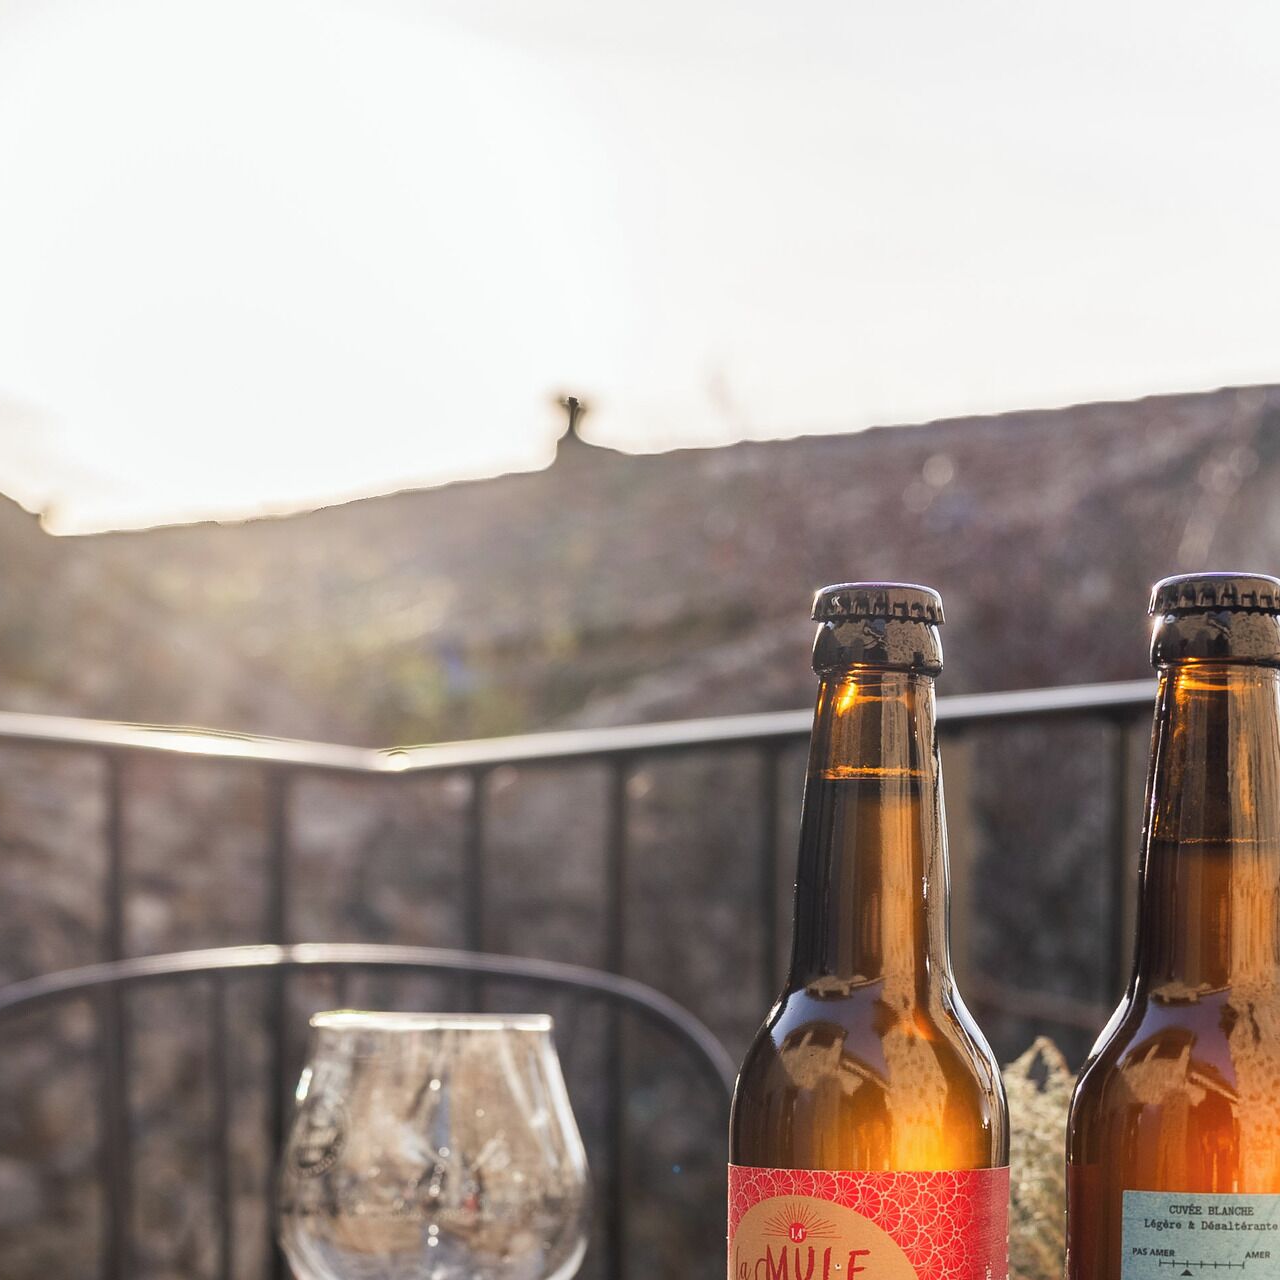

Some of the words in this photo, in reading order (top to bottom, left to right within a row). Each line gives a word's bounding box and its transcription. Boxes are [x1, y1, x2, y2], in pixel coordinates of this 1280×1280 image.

[1169, 1204, 1202, 1216] CUVÉE
[1208, 1206, 1254, 1216] BLANCHE
[1144, 1218, 1182, 1232] Légère
[1188, 1220, 1195, 1230] &
[1201, 1220, 1278, 1231] Désaltérante
[1132, 1247, 1148, 1256] PAS
[1150, 1248, 1175, 1257] AMER
[1245, 1251, 1271, 1259] AMER
